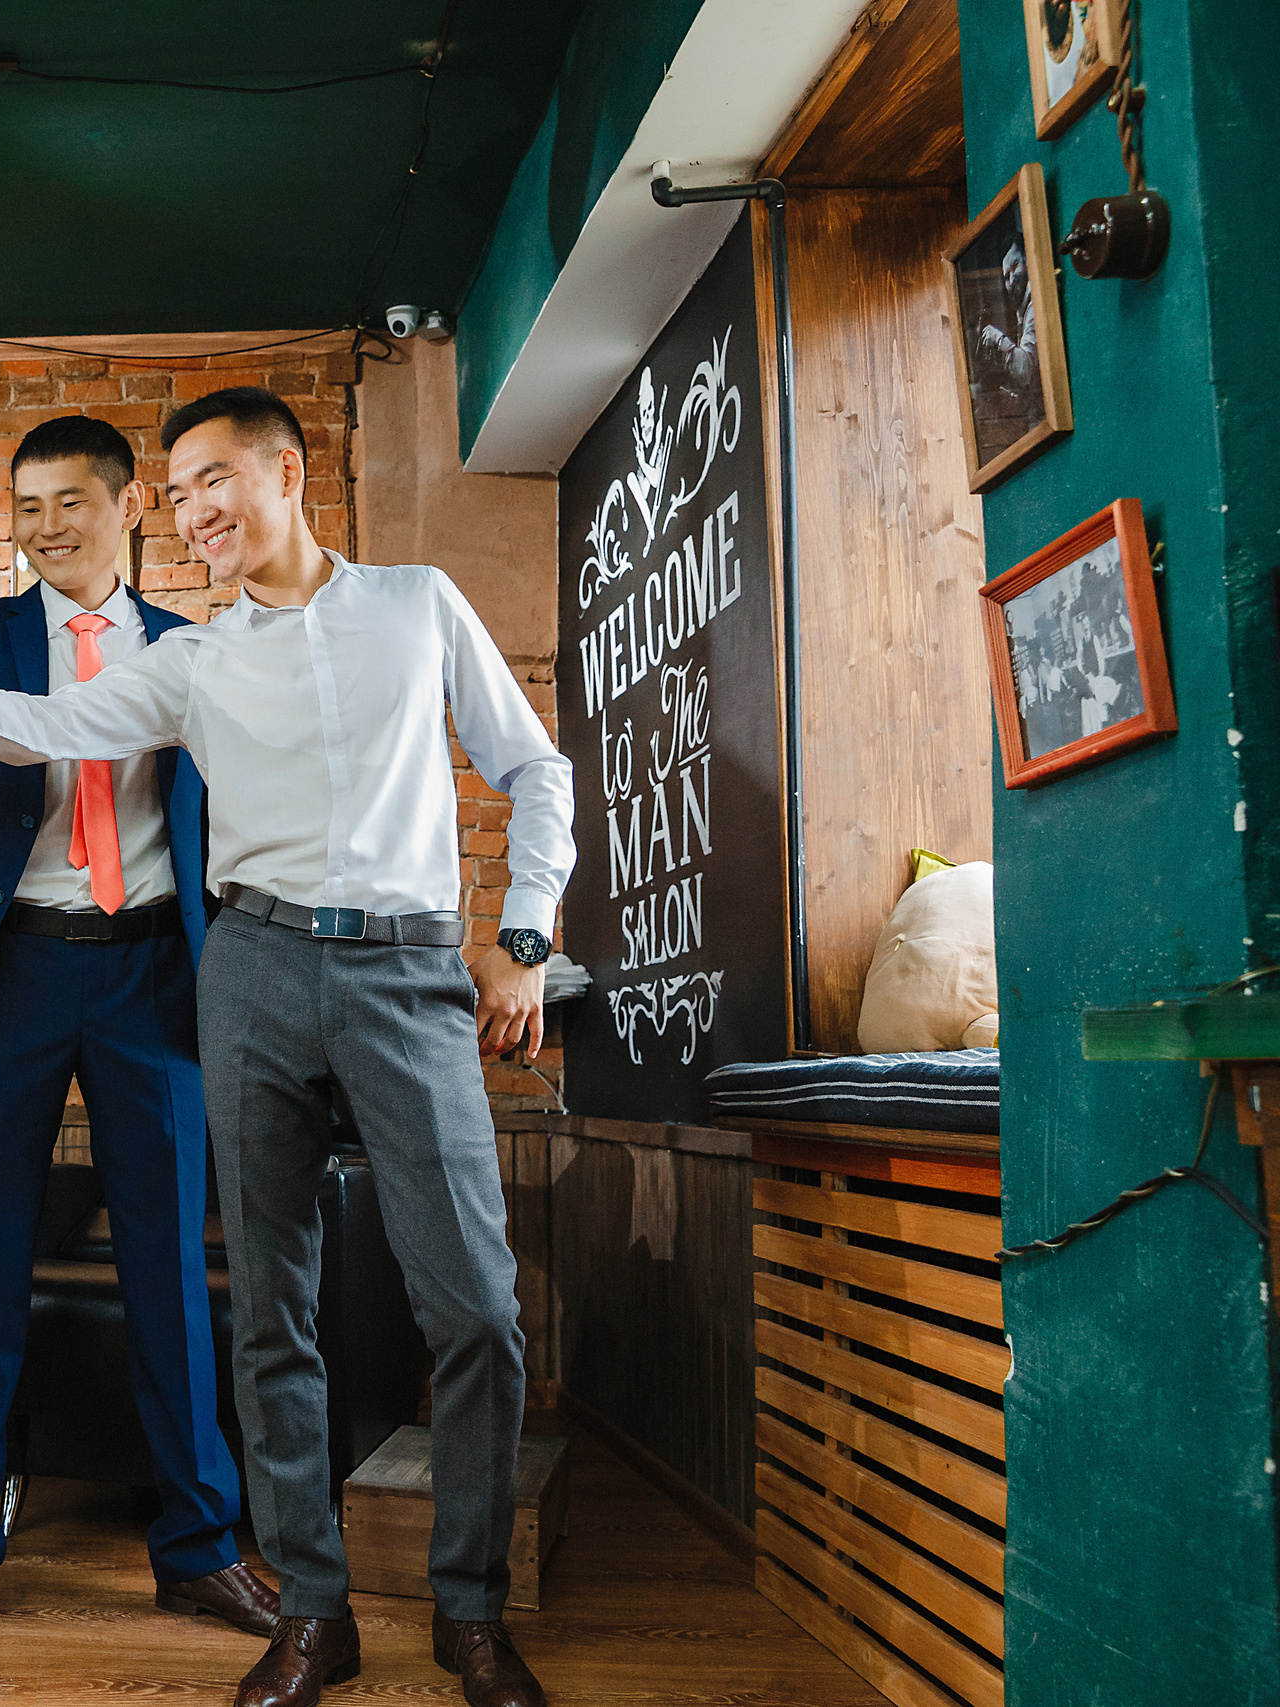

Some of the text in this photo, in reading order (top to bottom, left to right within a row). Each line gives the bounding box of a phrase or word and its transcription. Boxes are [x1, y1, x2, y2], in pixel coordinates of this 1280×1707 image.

[579, 490, 742, 718] WELCOME
[601, 658, 711, 807] to The
[606, 754, 713, 899] MAN
[620, 873, 703, 971] SALON
